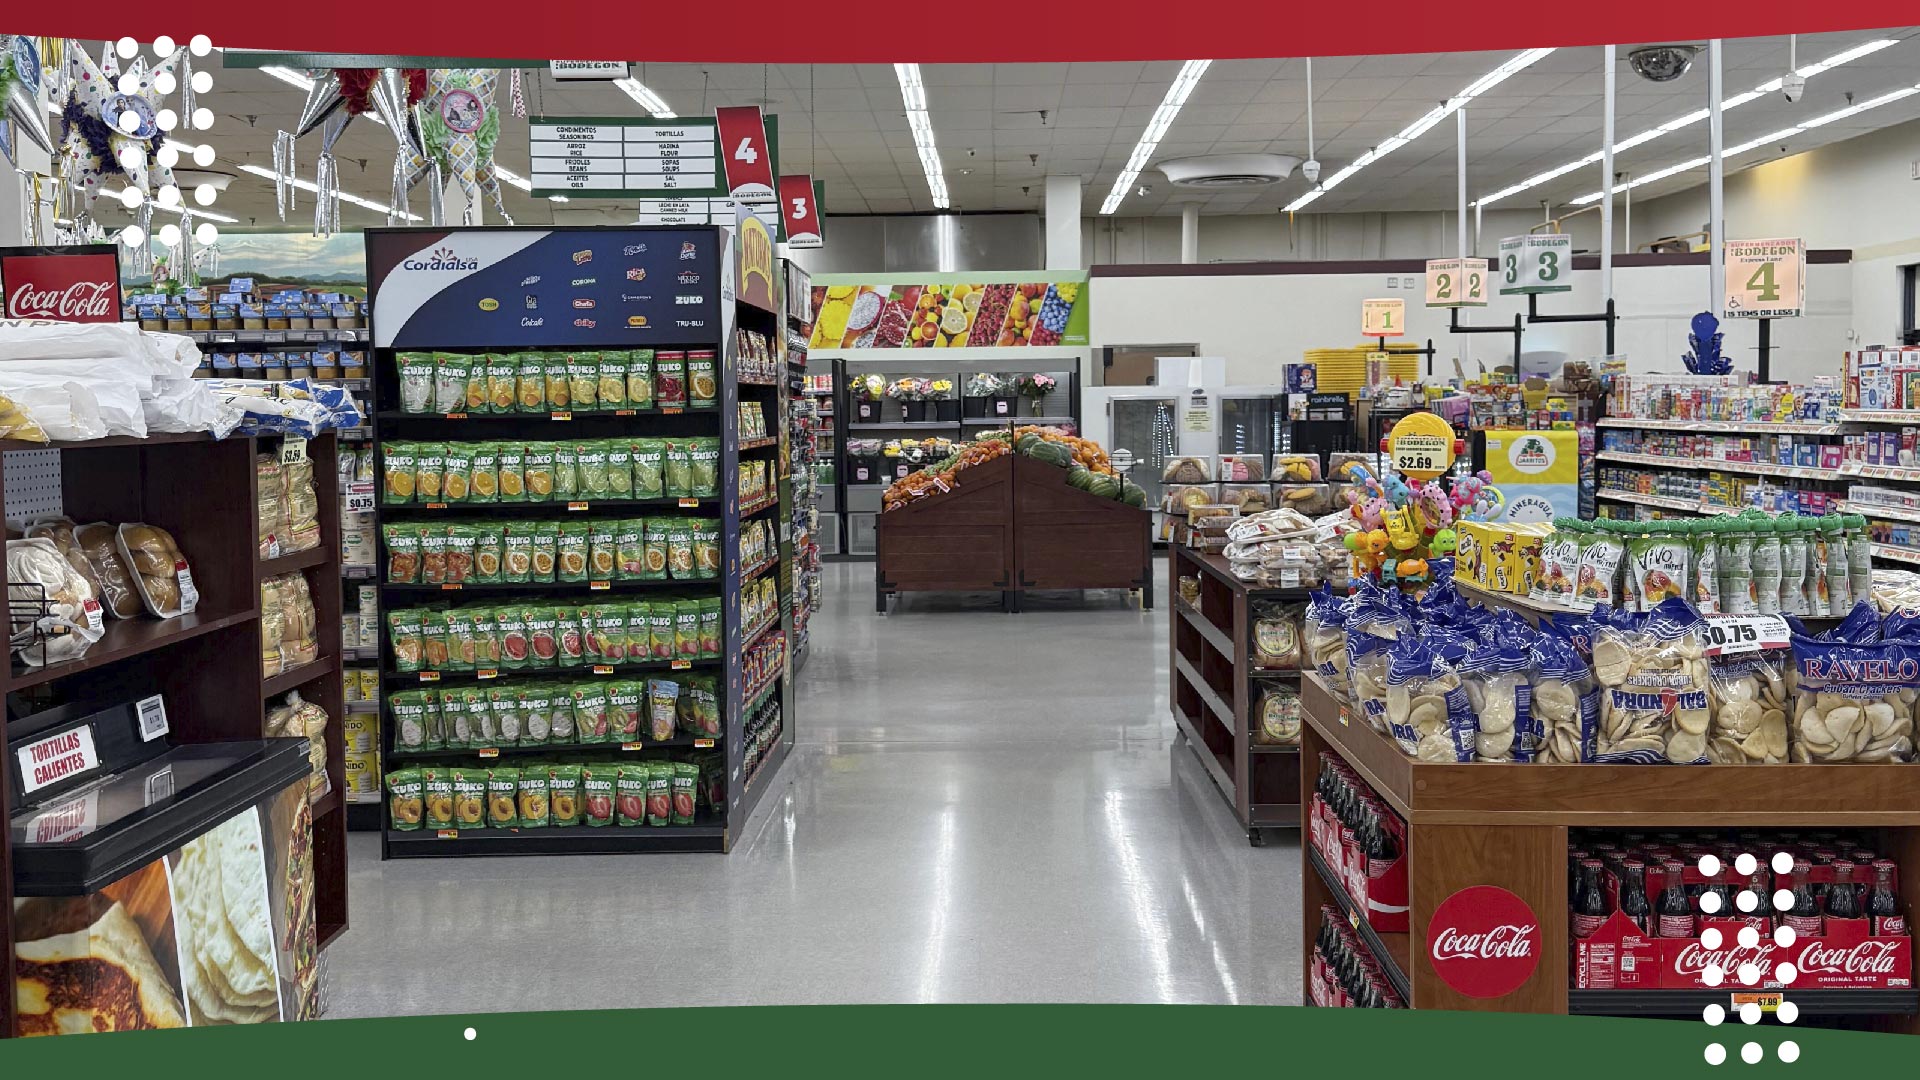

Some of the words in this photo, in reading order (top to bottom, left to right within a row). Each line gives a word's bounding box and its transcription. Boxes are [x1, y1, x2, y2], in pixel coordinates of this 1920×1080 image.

[556, 126, 597, 134] CONDIMENTOS
[735, 137, 758, 164] 4
[792, 198, 807, 219] 3
[1735, 246, 1796, 257] BODEGON
[404, 259, 478, 271] Cordialsa
[1506, 254, 1517, 284] 3
[1538, 251, 1559, 281] 3
[1436, 273, 1451, 298] 2
[1469, 272, 1481, 298] 2
[1746, 262, 1780, 301] 4
[9, 281, 116, 318] Coca-Cola
[675, 296, 704, 304] ZUKO
[1382, 311, 1394, 328] 1
[1399, 456, 1432, 469] $2.69
[1518, 457, 1546, 465] JARRITOS
[350, 498, 373, 508] $0.75
[1509, 498, 1553, 519] MINERAGUA
[596, 618, 622, 627] ZUKO
[1804, 658, 1919, 682] RAVELO
[1627, 674, 1667, 687] CRACKERS
[1823, 683, 1856, 694] Cuban
[1859, 683, 1902, 694] Crackers
[577, 696, 606, 708] ZUKO
[611, 696, 638, 705] ZUKO
[394, 705, 423, 714] ZUKO
[29, 732, 81, 763] TORTILLAS
[34, 752, 85, 785] CALIENTES
[454, 782, 484, 791] ZUKO
[585, 781, 612, 790] ZUKO
[1433, 924, 1536, 961] Coca-Cola
[1797, 941, 1902, 974] Coca-Cola
[1579, 955, 1587, 988] ECYCLE
[1757, 998, 1778, 1006] $7.99
